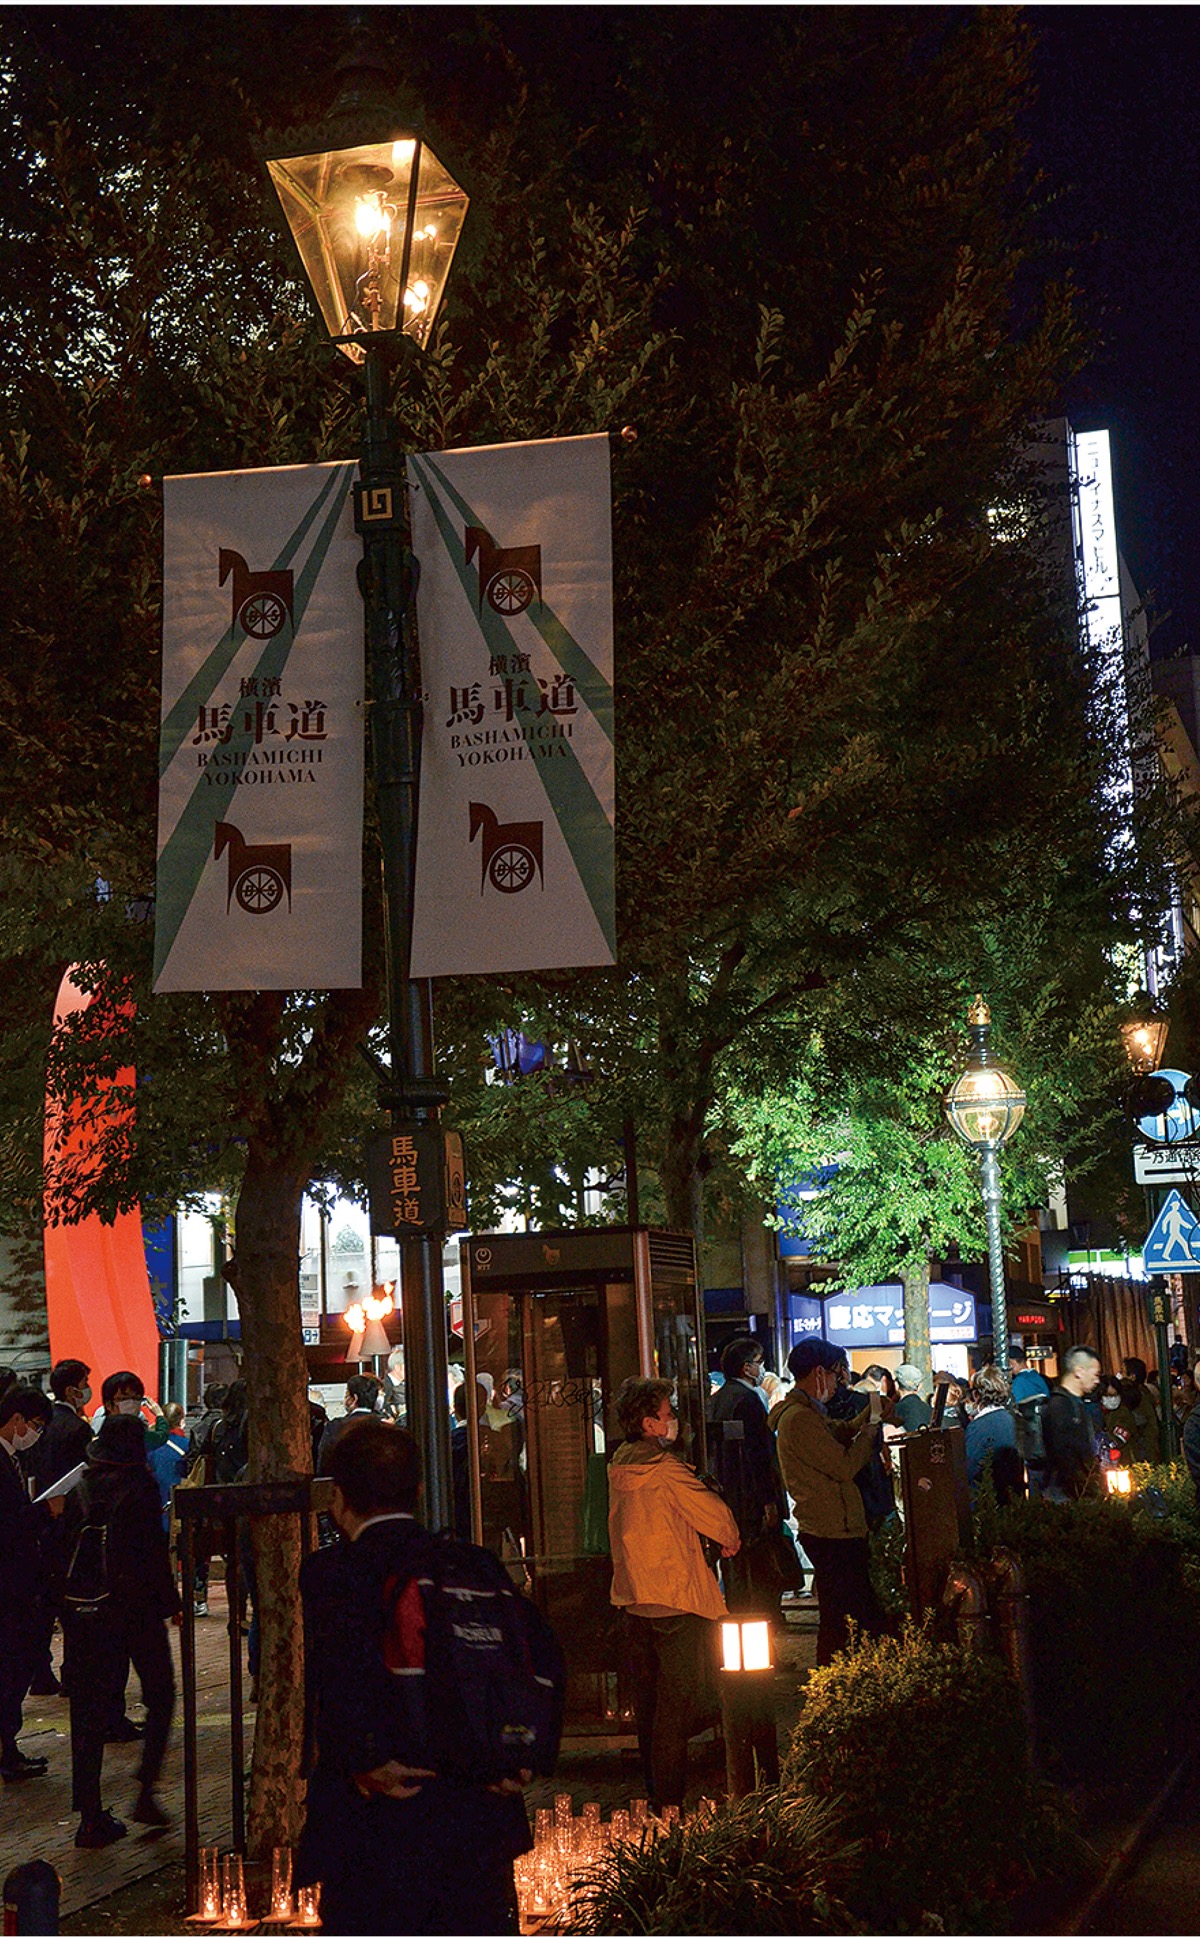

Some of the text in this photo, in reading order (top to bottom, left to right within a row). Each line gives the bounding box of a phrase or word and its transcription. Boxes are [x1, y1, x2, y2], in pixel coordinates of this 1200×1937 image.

[446, 673, 579, 728] 馬車道
[192, 699, 328, 745] 馬車道
[451, 723, 573, 749] BASHAMICHI
[197, 749, 323, 768] BASHAMICHI
[457, 744, 567, 767] YOKOHAMA
[204, 768, 316, 786] YOKOHAMA
[388, 1135, 425, 1228] 馬車道
[829, 1300, 973, 1331] 慶応マッージ
